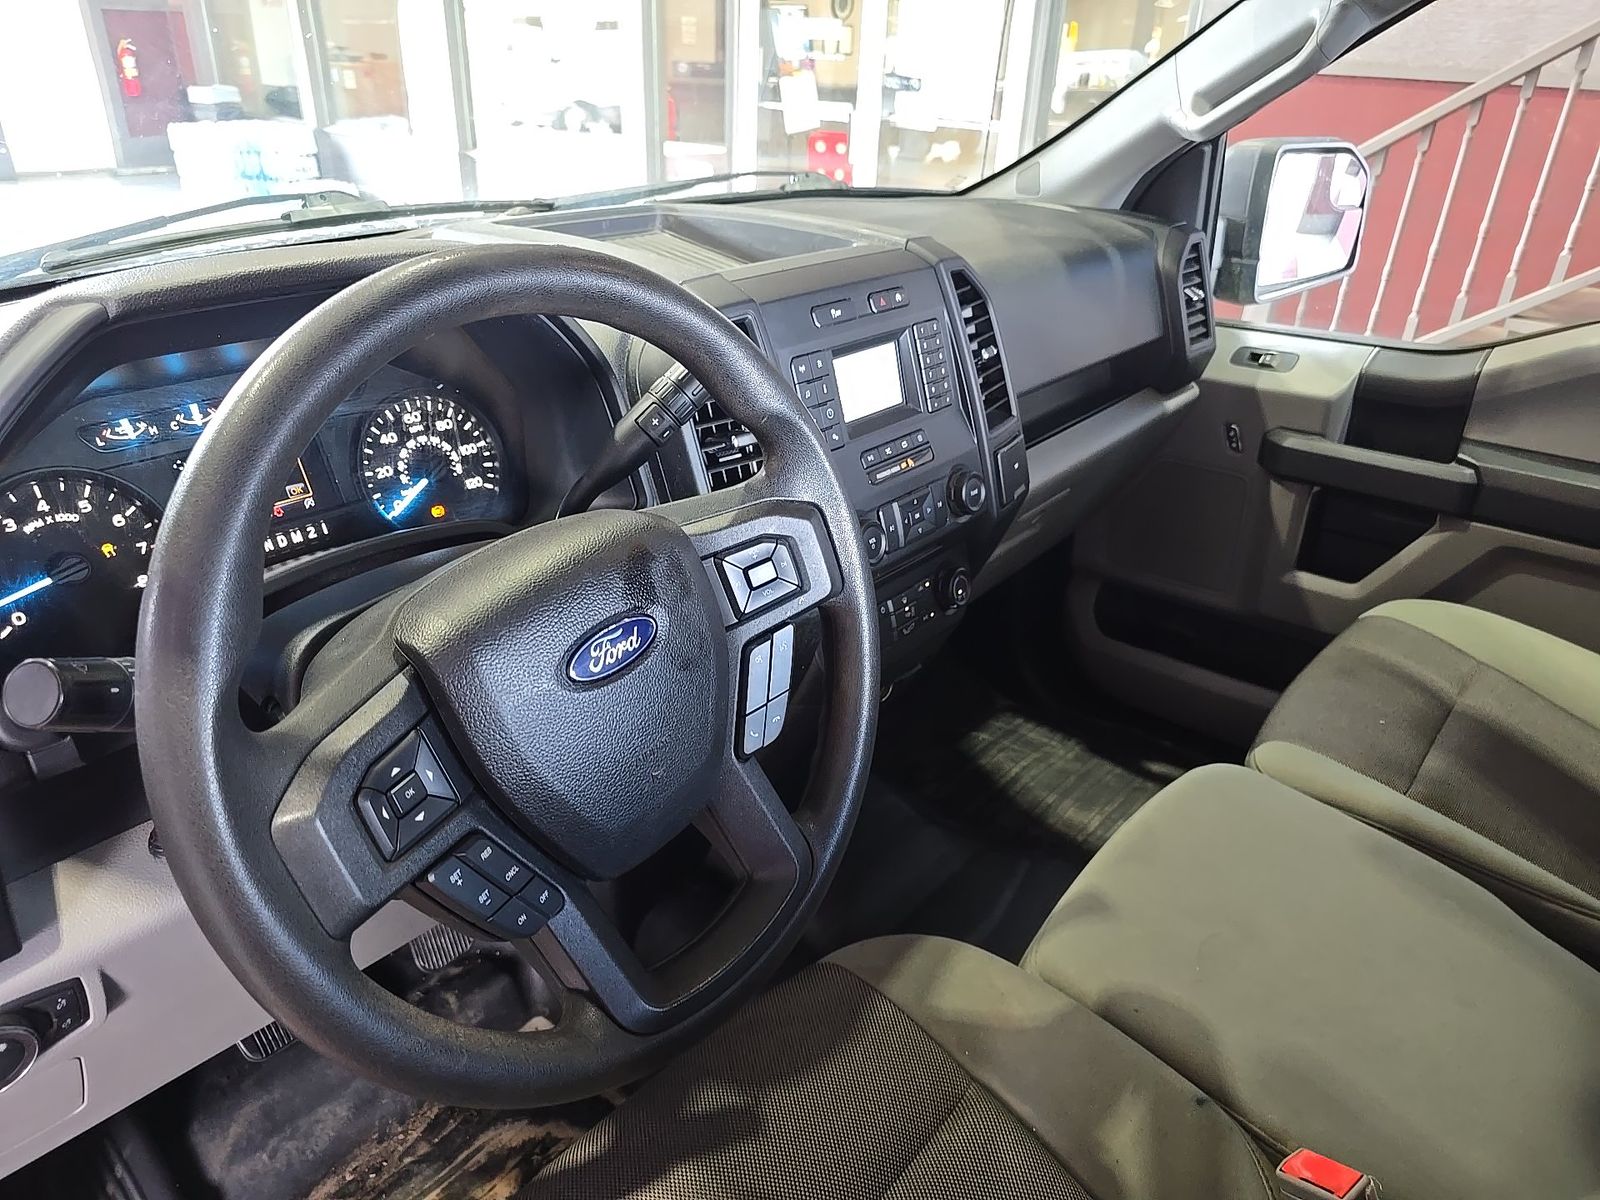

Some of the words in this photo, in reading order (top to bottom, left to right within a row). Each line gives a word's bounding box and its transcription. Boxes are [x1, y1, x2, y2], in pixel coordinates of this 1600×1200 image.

[403, 411, 421, 424] 60
[435, 418, 453, 431] 80
[169, 420, 180, 431] C
[379, 431, 398, 445] 40
[459, 442, 478, 456] 100
[374, 465, 394, 479] 20
[290, 486, 304, 496] OK
[36, 499, 51, 513] 4
[78, 500, 92, 513] 5
[54, 512, 80, 522] 1000
[112, 514, 126, 527] 6
[2, 517, 18, 533] 3
[264, 538, 275, 552] N
[276, 534, 288, 548] D
[290, 529, 304, 544] M
[306, 526, 318, 539] 2
[135, 541, 147, 555] 7
[11, 611, 27, 626] 0
[588, 625, 642, 673] Ford
[404, 787, 416, 799] OK
[449, 868, 462, 884] SET
[505, 864, 520, 882] CNCL
[478, 888, 491, 904] SET
[539, 889, 549, 904] OFF
[517, 912, 527, 926] ON
